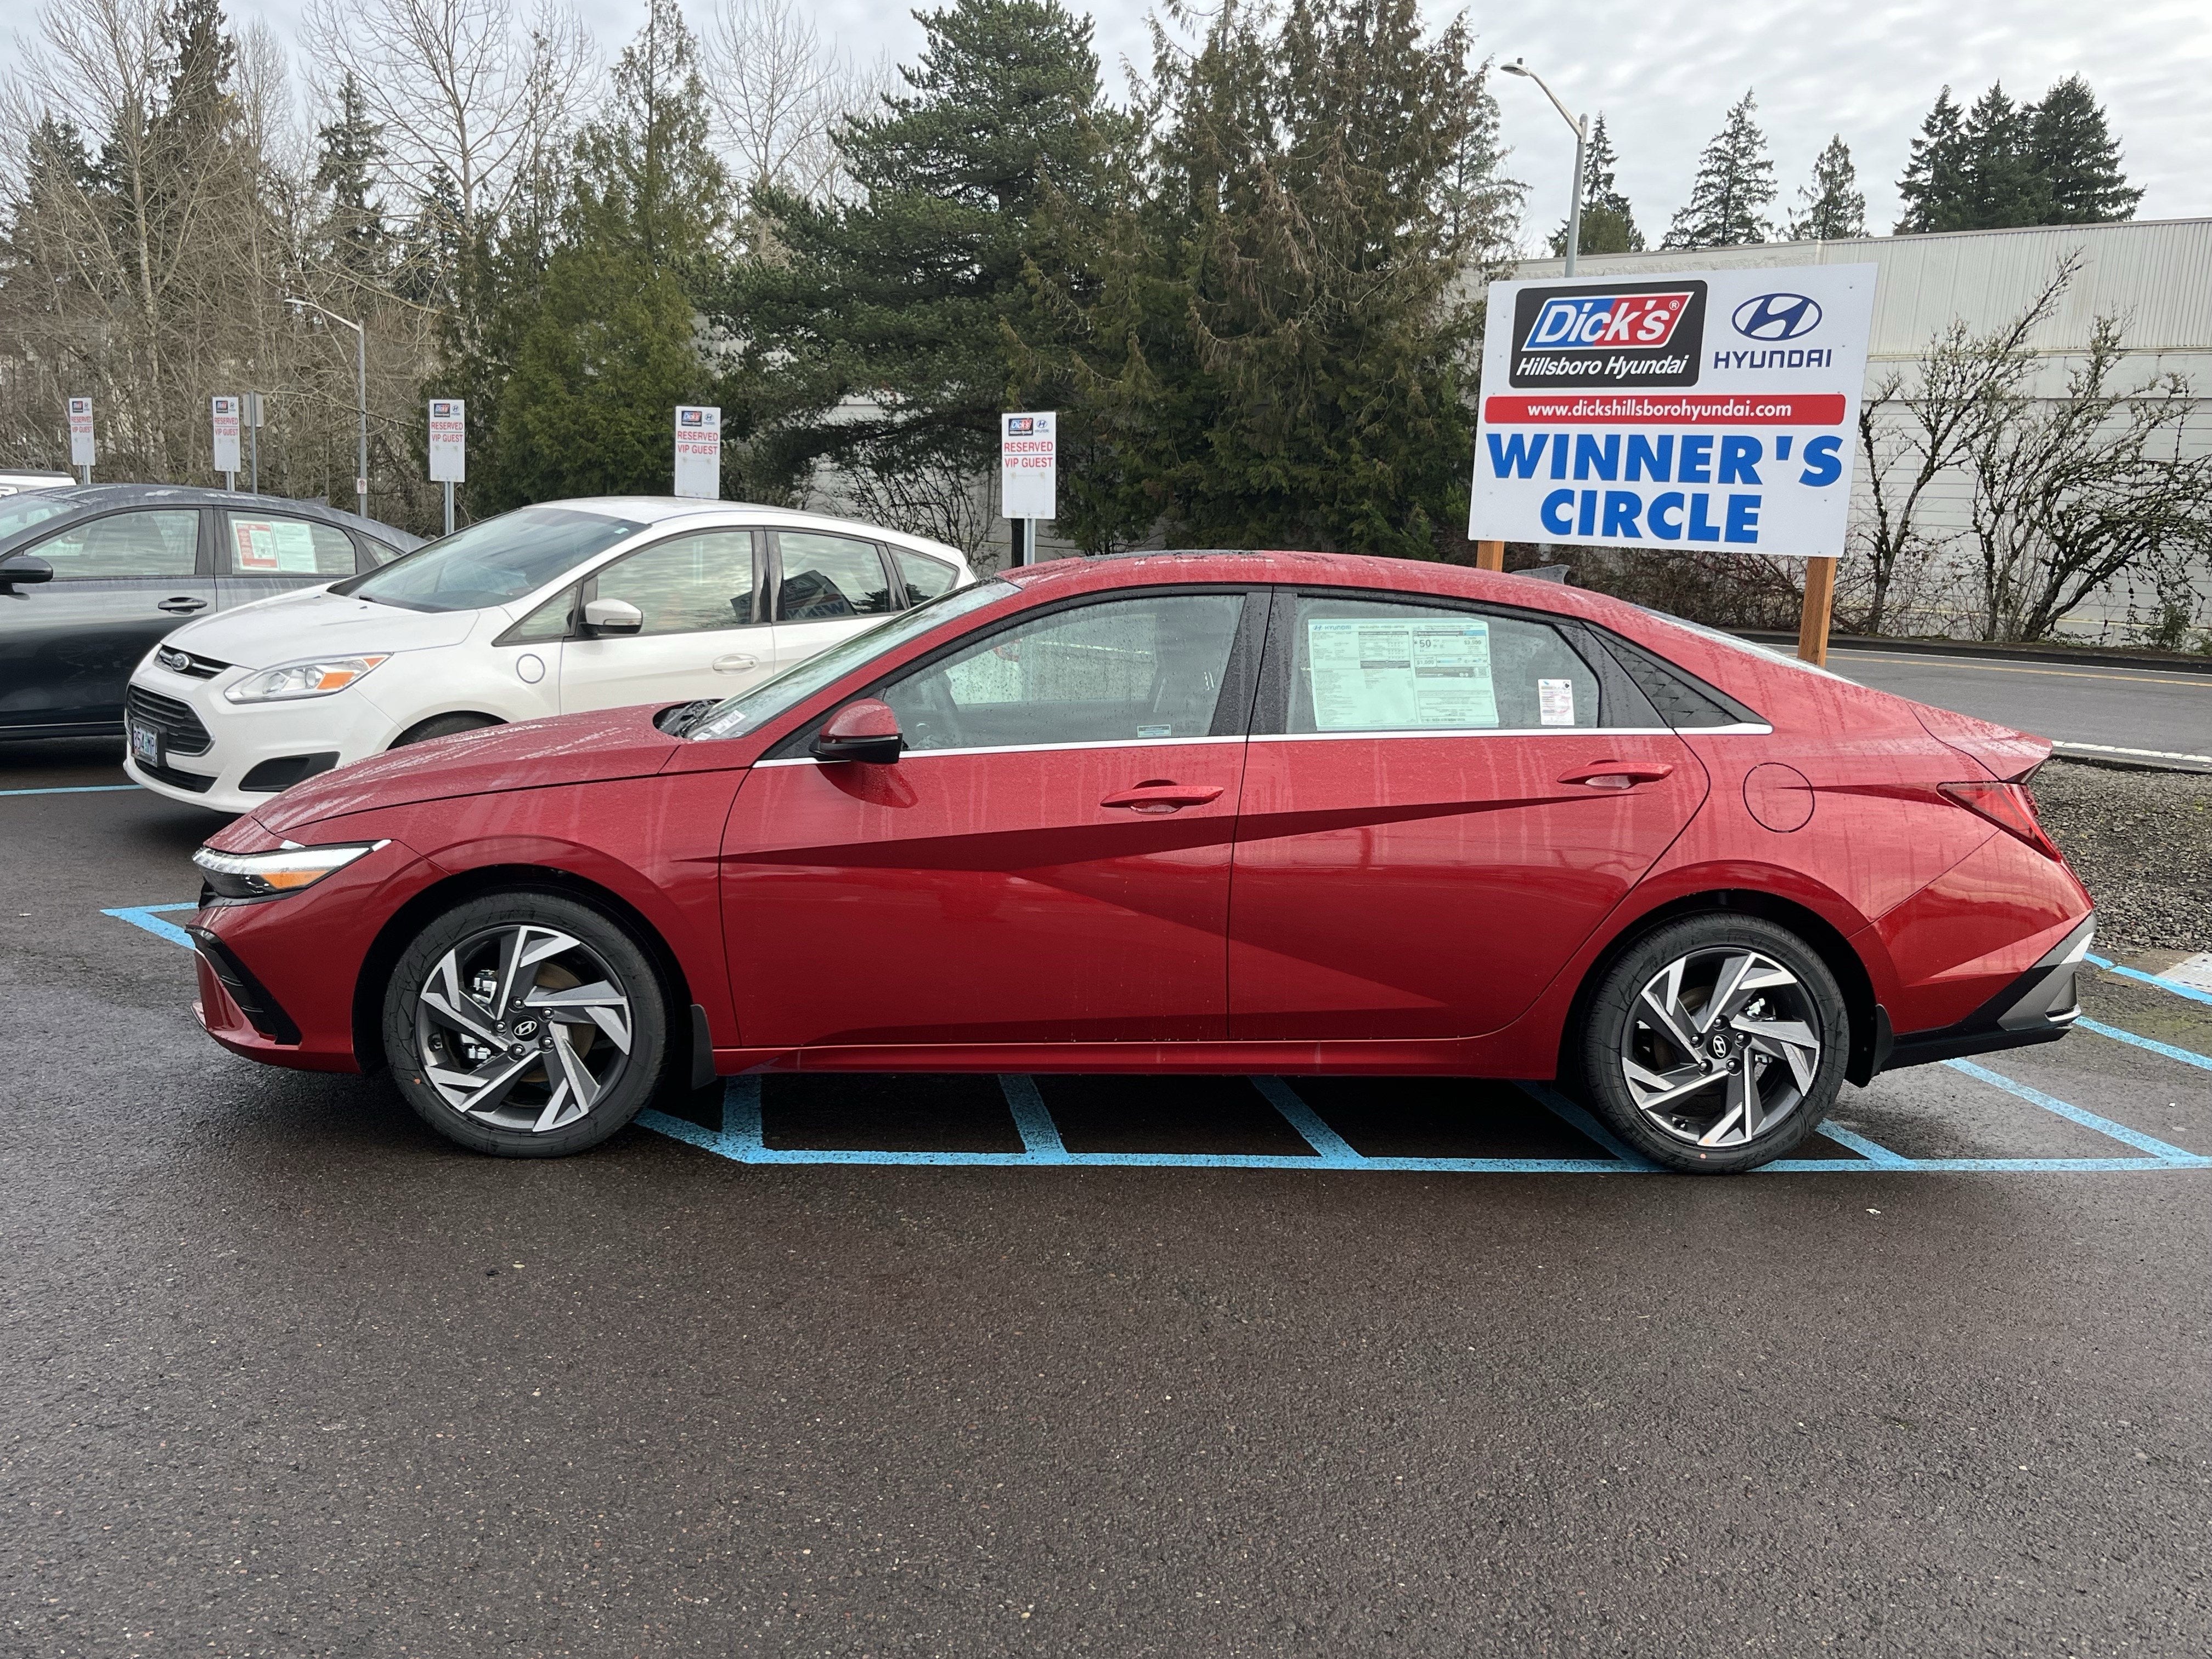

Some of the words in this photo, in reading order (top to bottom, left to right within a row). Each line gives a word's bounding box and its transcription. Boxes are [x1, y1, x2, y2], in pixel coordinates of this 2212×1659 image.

[1713, 348, 1832, 369] HYUNDAI
[1516, 356, 1600, 376] Hillsboro
[1605, 354, 1690, 379] Hyundai
[1527, 399, 1792, 421] www.dickshillsborohyundai.com
[431, 422, 463, 431] RESERVED
[443, 434, 463, 442] GUEST
[678, 431, 718, 441] RESERVED
[678, 444, 690, 453] VIP
[692, 445, 718, 455] GUEST
[1004, 442, 1053, 452] RESERVED
[1005, 458, 1019, 467] VIP
[1022, 457, 1053, 467] GUEST
[1486, 433, 1843, 487] WINNER'S
[1540, 488, 1762, 544] CIRCLE
[1419, 639, 1431, 647] 50
